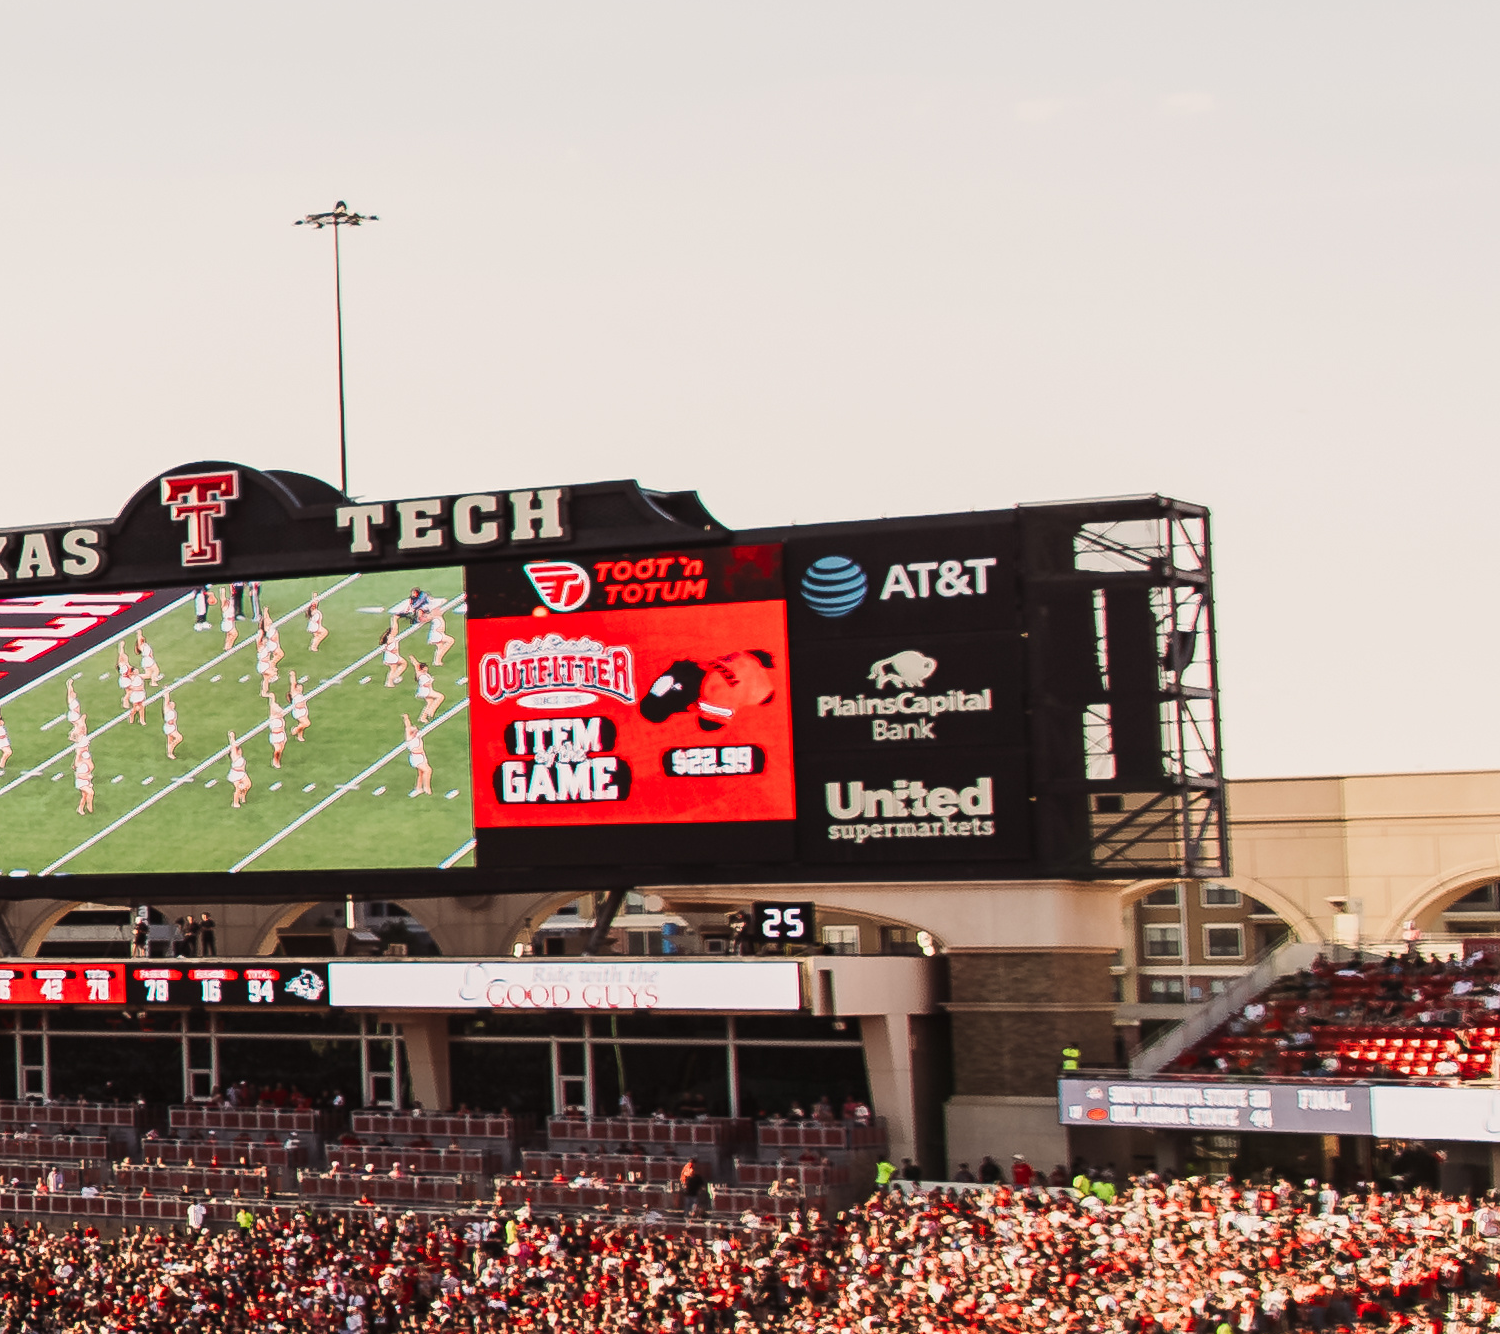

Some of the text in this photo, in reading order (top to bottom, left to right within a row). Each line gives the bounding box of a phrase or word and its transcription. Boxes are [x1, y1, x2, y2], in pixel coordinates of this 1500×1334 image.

[336, 488, 565, 555] TECH
[594, 557, 675, 582] TOOT
[880, 557, 996, 600] AT&T
[604, 579, 708, 605] TOTUM
[480, 646, 636, 704] OUTFITTER
[817, 688, 992, 717] PlainsCapital
[513, 717, 602, 755] ITEM
[872, 718, 936, 741] Bank
[671, 746, 753, 774] $22.99
[502, 757, 619, 803] GAME
[825, 777, 994, 819] United
[828, 817, 995, 843] supermarkets
[762, 908, 804, 938] 25
[532, 965, 658, 983] Ride with the
[40, 978, 64, 1000] 42
[247, 980, 274, 1002] 94
[486, 984, 658, 1008] GOOD GUYS
